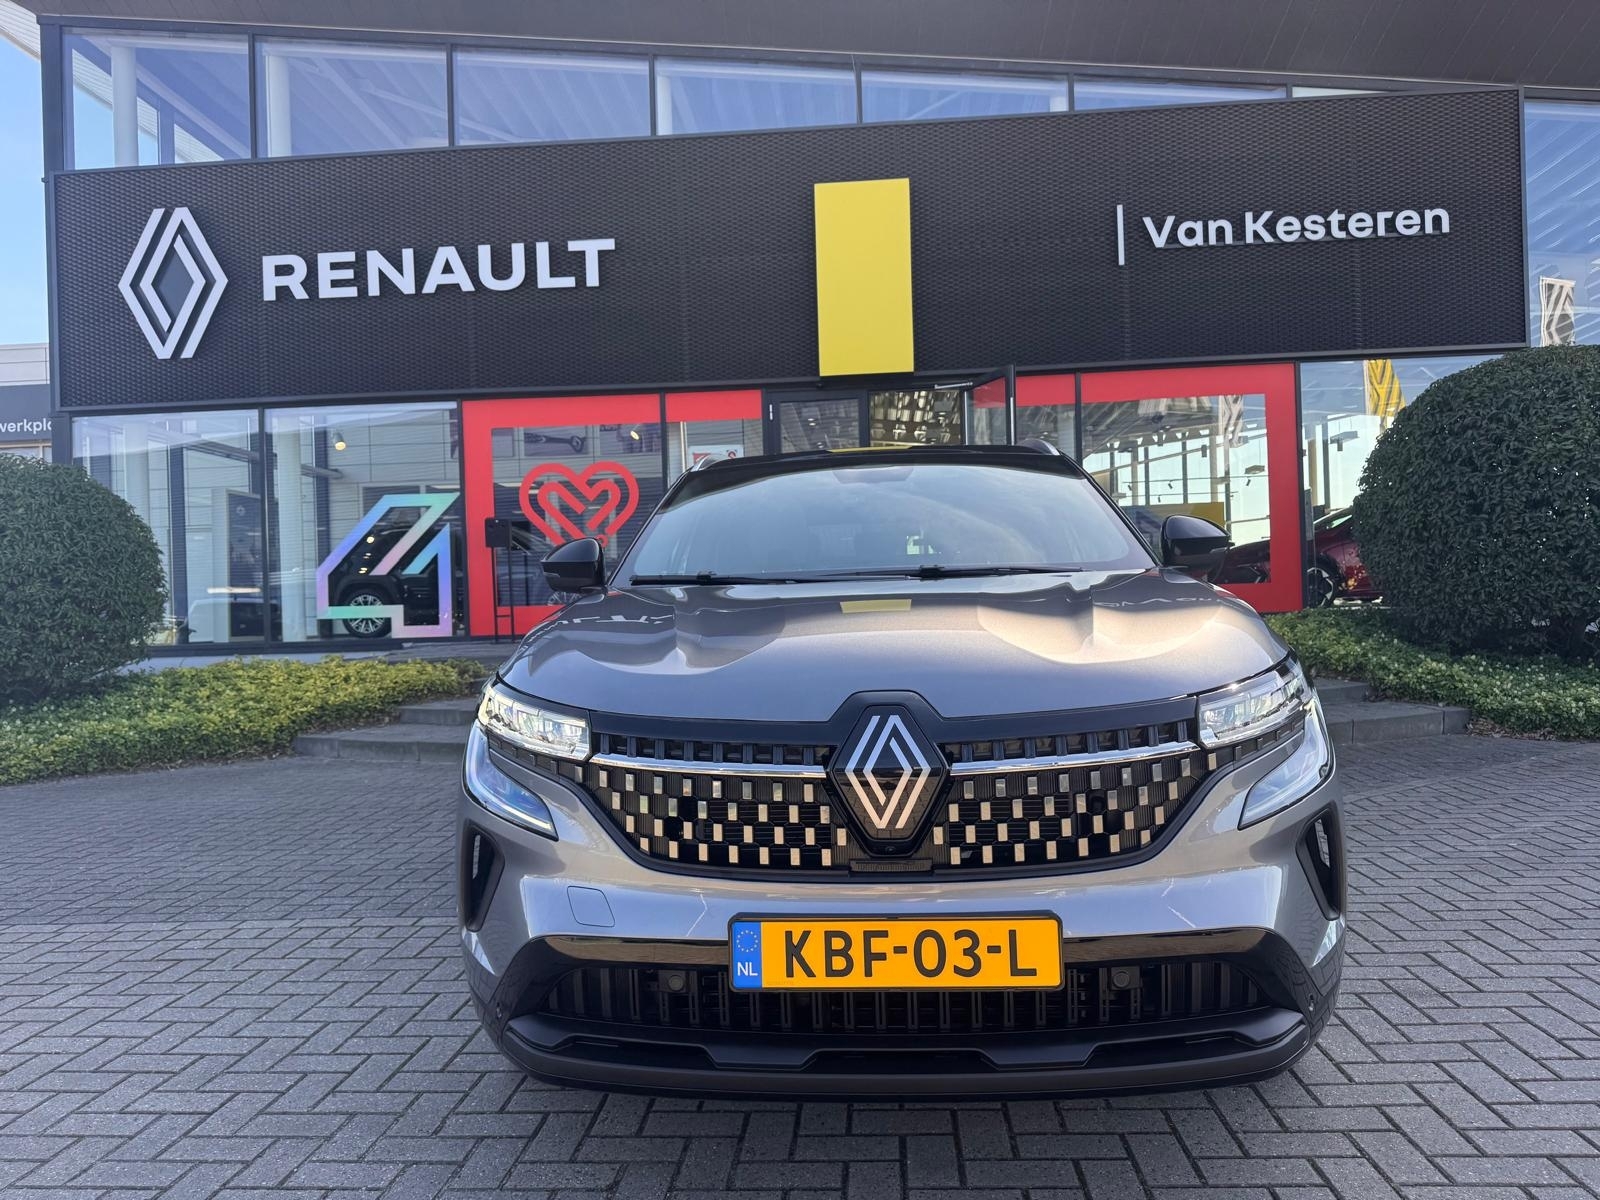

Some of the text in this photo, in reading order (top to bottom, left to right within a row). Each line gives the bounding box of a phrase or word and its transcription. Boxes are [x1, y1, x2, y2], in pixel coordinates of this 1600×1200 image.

[1143, 208, 1450, 248] Van Kesteren
[262, 238, 616, 301] RENAULT
[737, 961, 758, 976] NL
[784, 928, 1038, 979] KBF-03-L
